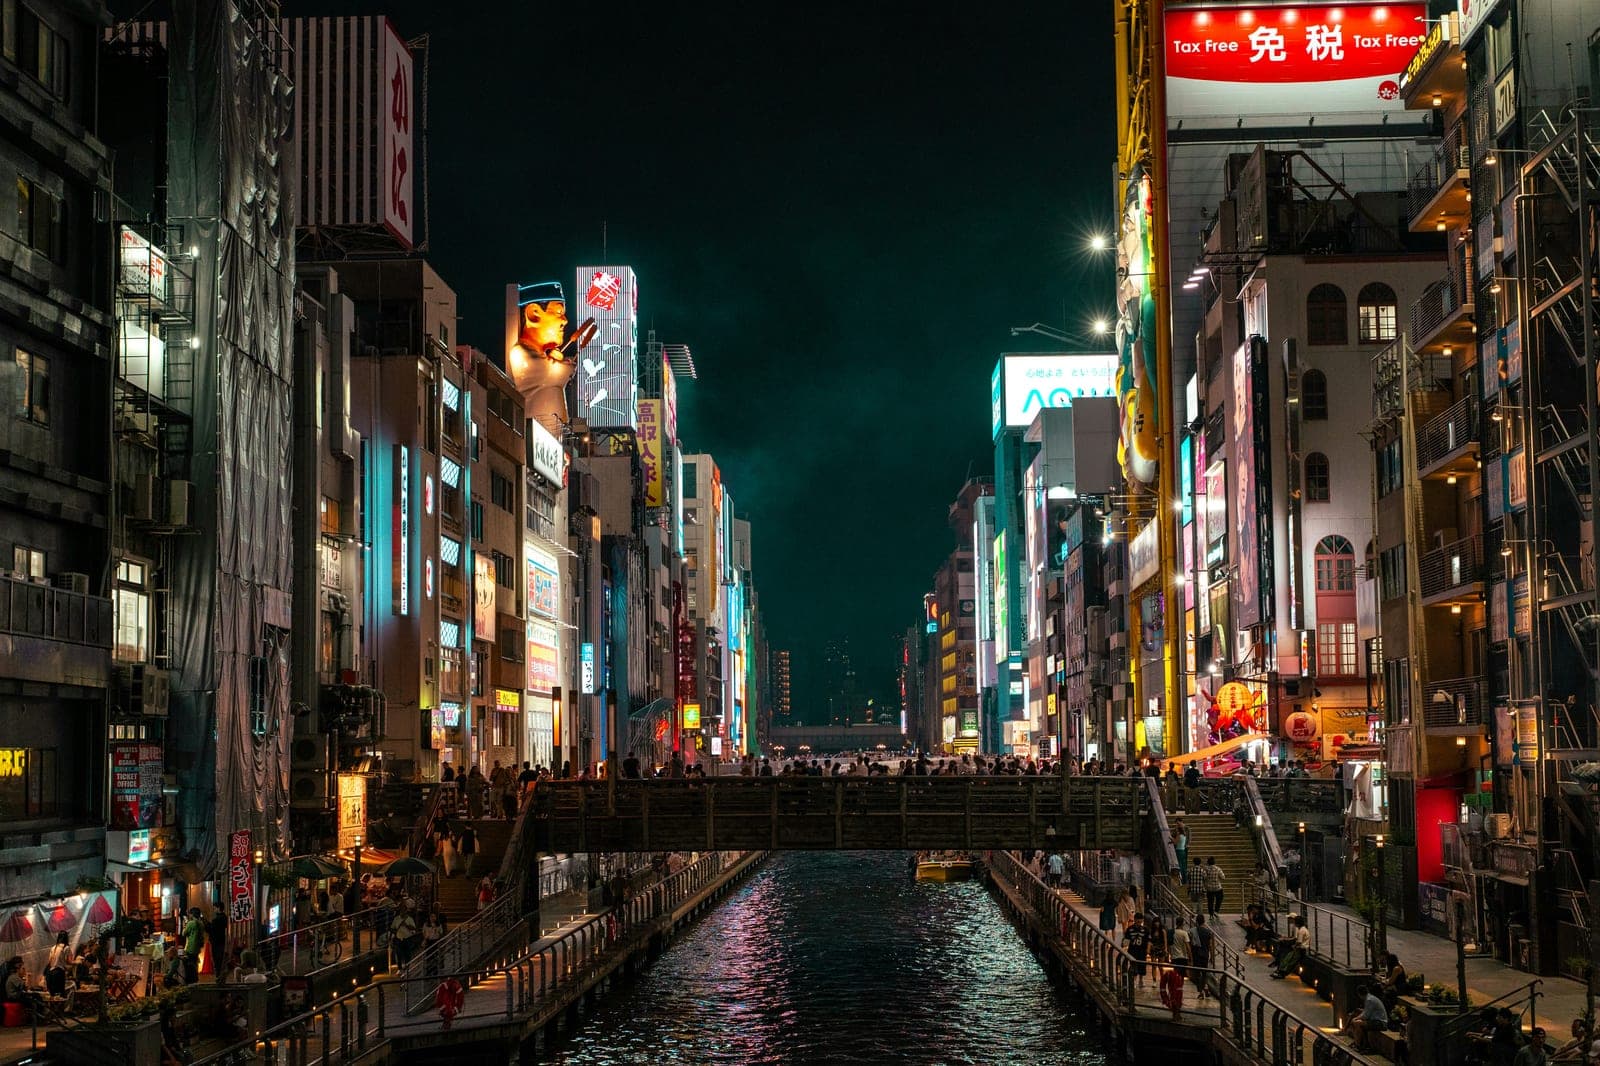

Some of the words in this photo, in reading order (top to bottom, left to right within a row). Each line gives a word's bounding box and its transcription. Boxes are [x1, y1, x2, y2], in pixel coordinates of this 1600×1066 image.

[1173, 40, 1201, 53] Tax
[1205, 40, 1238, 53] Free
[1248, 24, 1345, 62] 免税
[1353, 34, 1381, 48] Tax
[1386, 33, 1418, 47] Free
[117, 780, 137, 788] OFFICE
